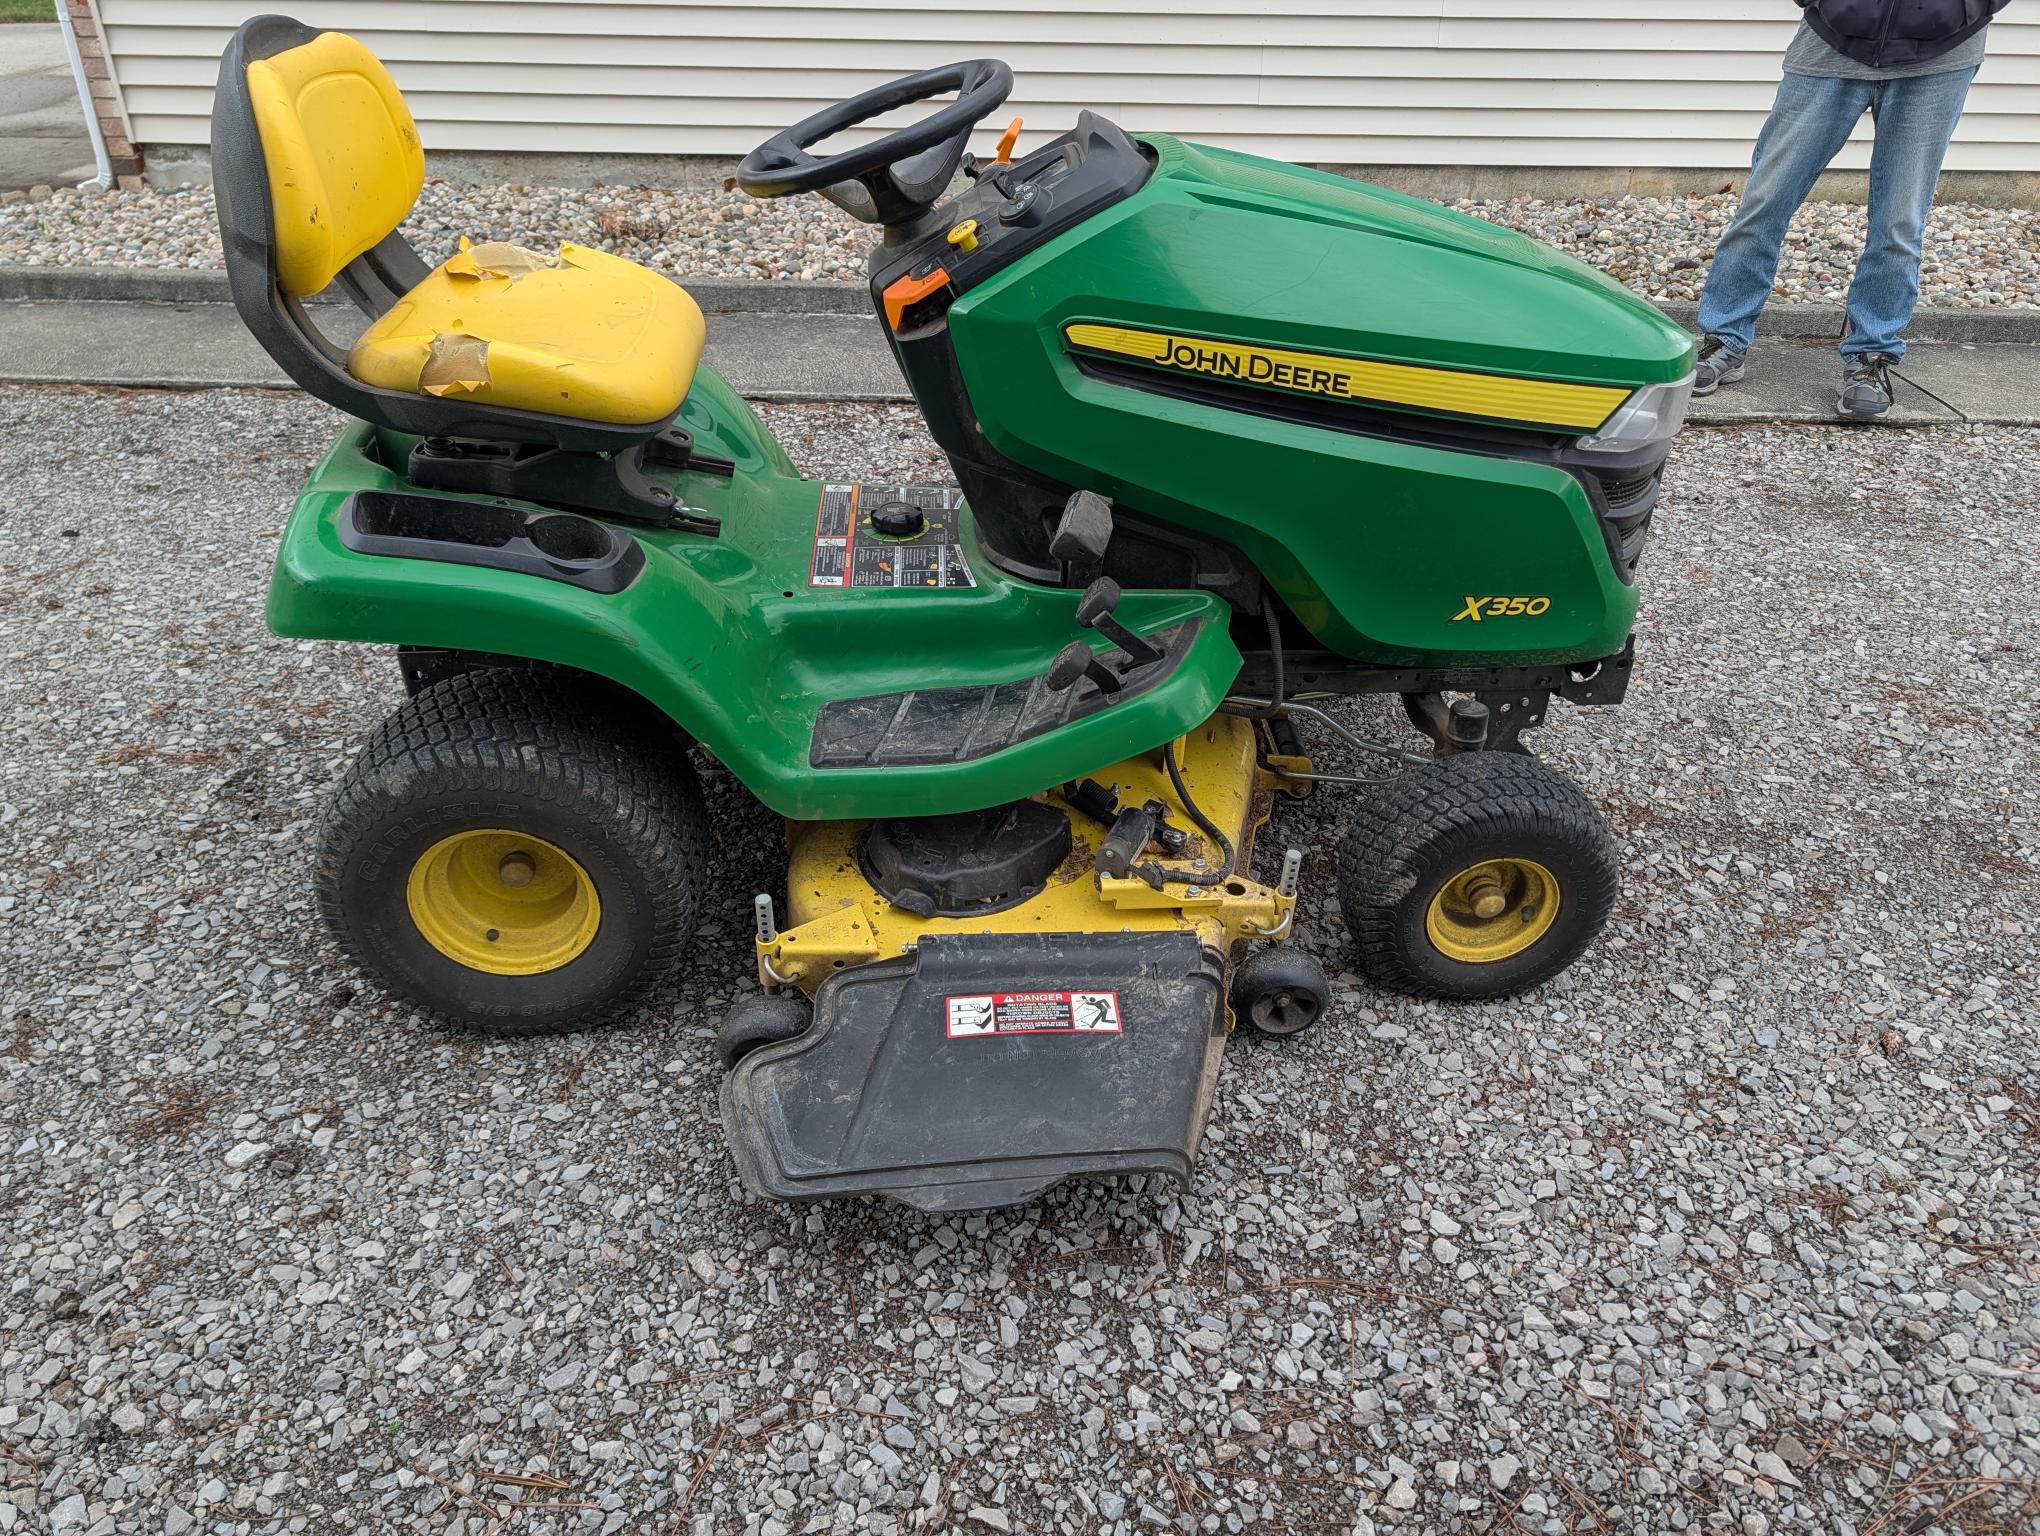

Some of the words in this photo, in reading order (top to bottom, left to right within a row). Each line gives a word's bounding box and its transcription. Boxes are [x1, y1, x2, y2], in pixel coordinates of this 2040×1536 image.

[1154, 338, 1241, 376] JOHN
[1248, 354, 1352, 395] DEERE
[1451, 596, 1551, 621] X350
[358, 801, 520, 881] CARLISLE
[1016, 993, 1063, 1002] DANGER
